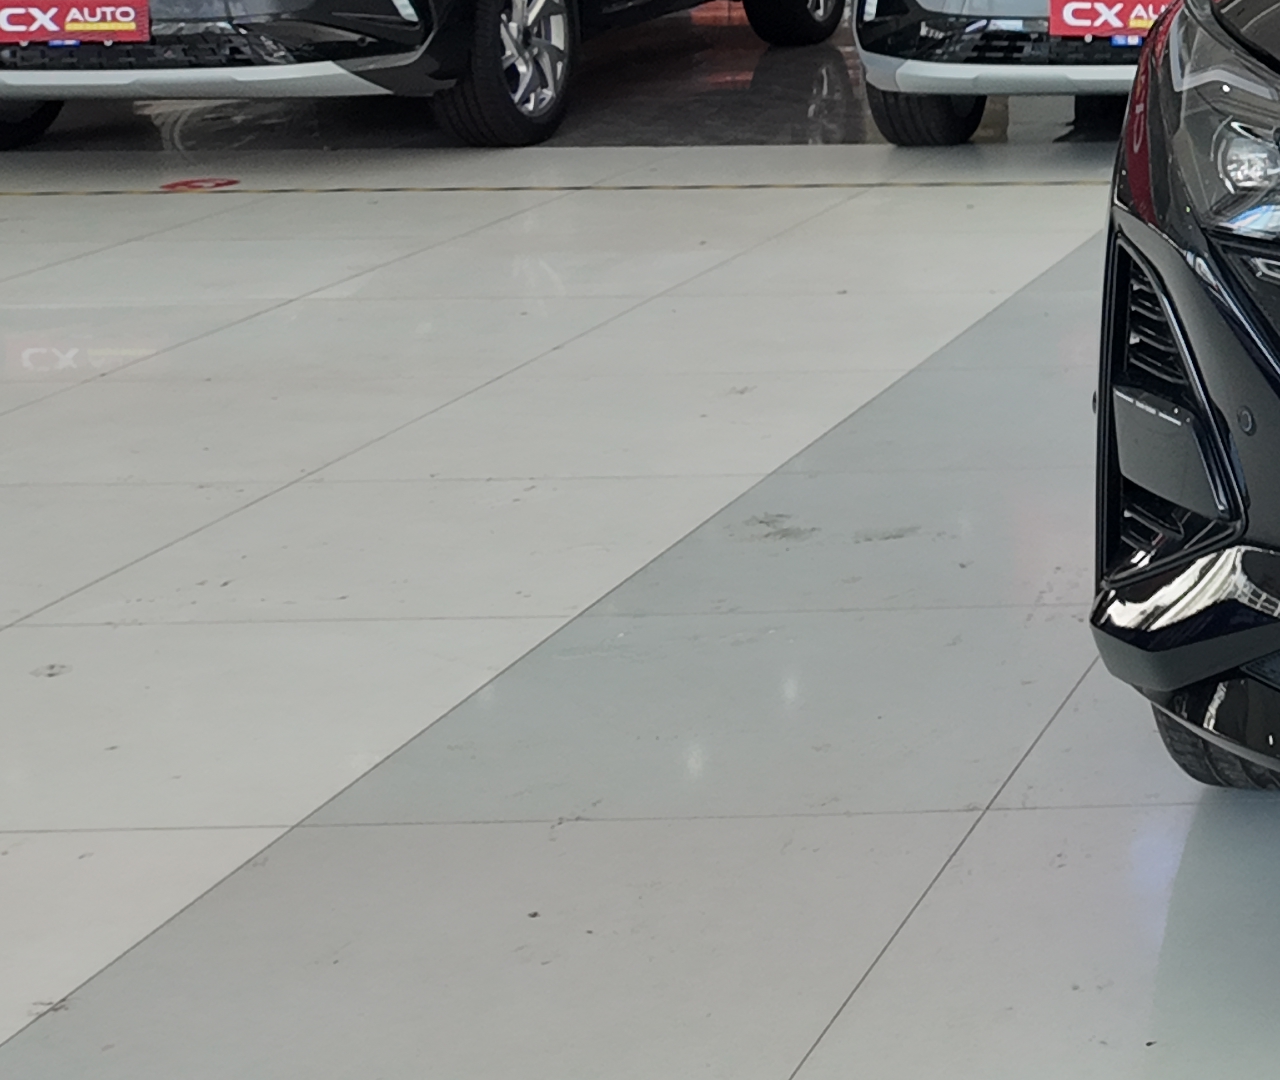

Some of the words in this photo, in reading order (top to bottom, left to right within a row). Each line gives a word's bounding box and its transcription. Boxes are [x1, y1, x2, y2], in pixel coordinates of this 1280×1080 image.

[0, 7, 60, 32] CX
[65, 6, 136, 22] AUTO
[1063, 1, 1124, 28] CX
[1130, 3, 1169, 19] AU
